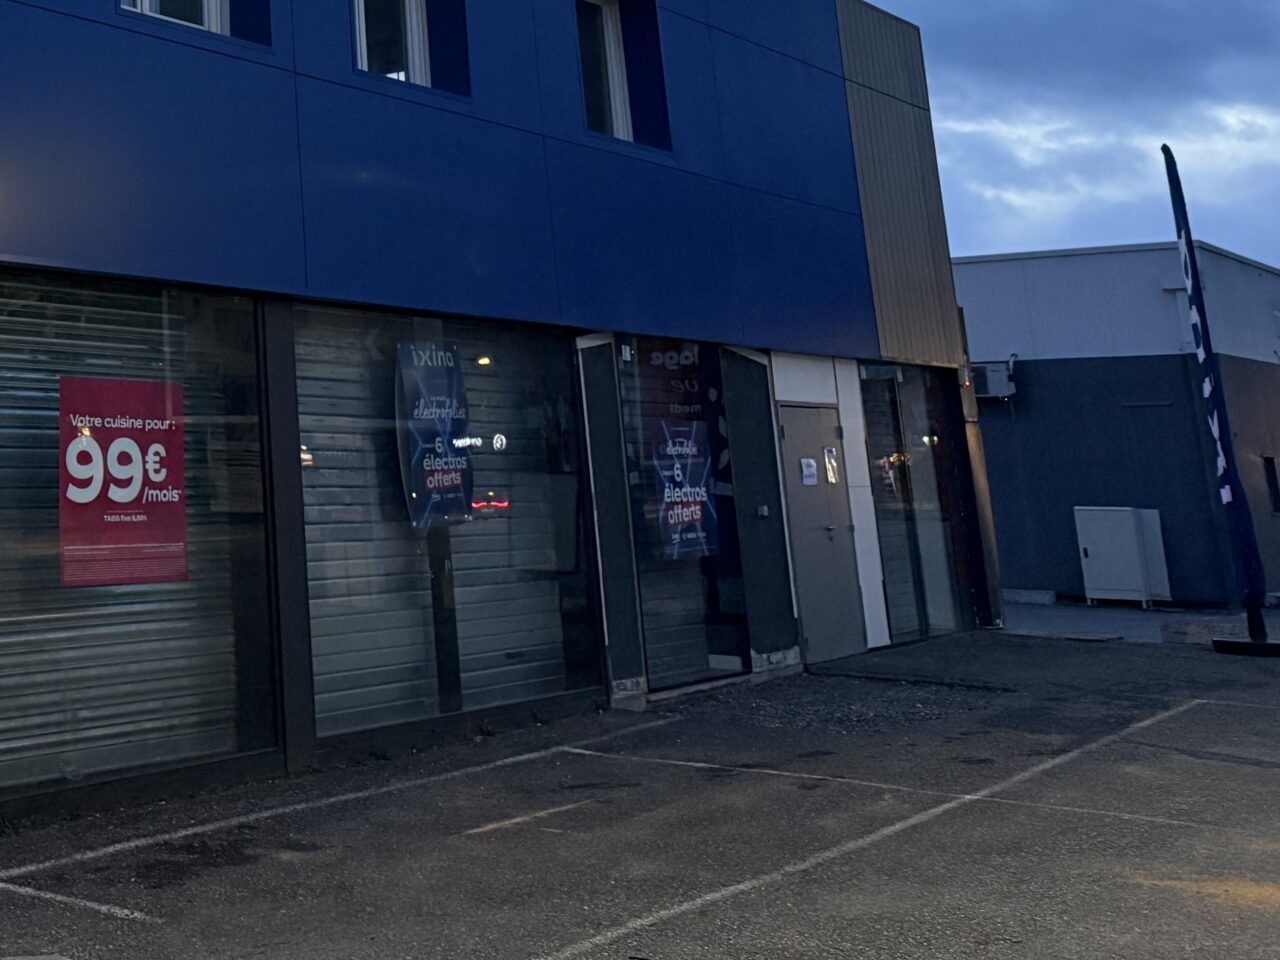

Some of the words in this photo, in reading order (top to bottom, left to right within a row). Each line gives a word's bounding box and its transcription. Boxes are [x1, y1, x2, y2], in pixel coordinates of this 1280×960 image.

[410, 345, 455, 367] ixina
[70, 414, 102, 427] Votre
[104, 415, 143, 429] cuisine
[145, 419, 171, 432] pour
[434, 437, 443, 453] 6
[423, 453, 468, 470] électros
[426, 470, 462, 489] offerts
[673, 463, 682, 482] 6
[664, 483, 707, 502] électros
[668, 504, 701, 524] offerts
